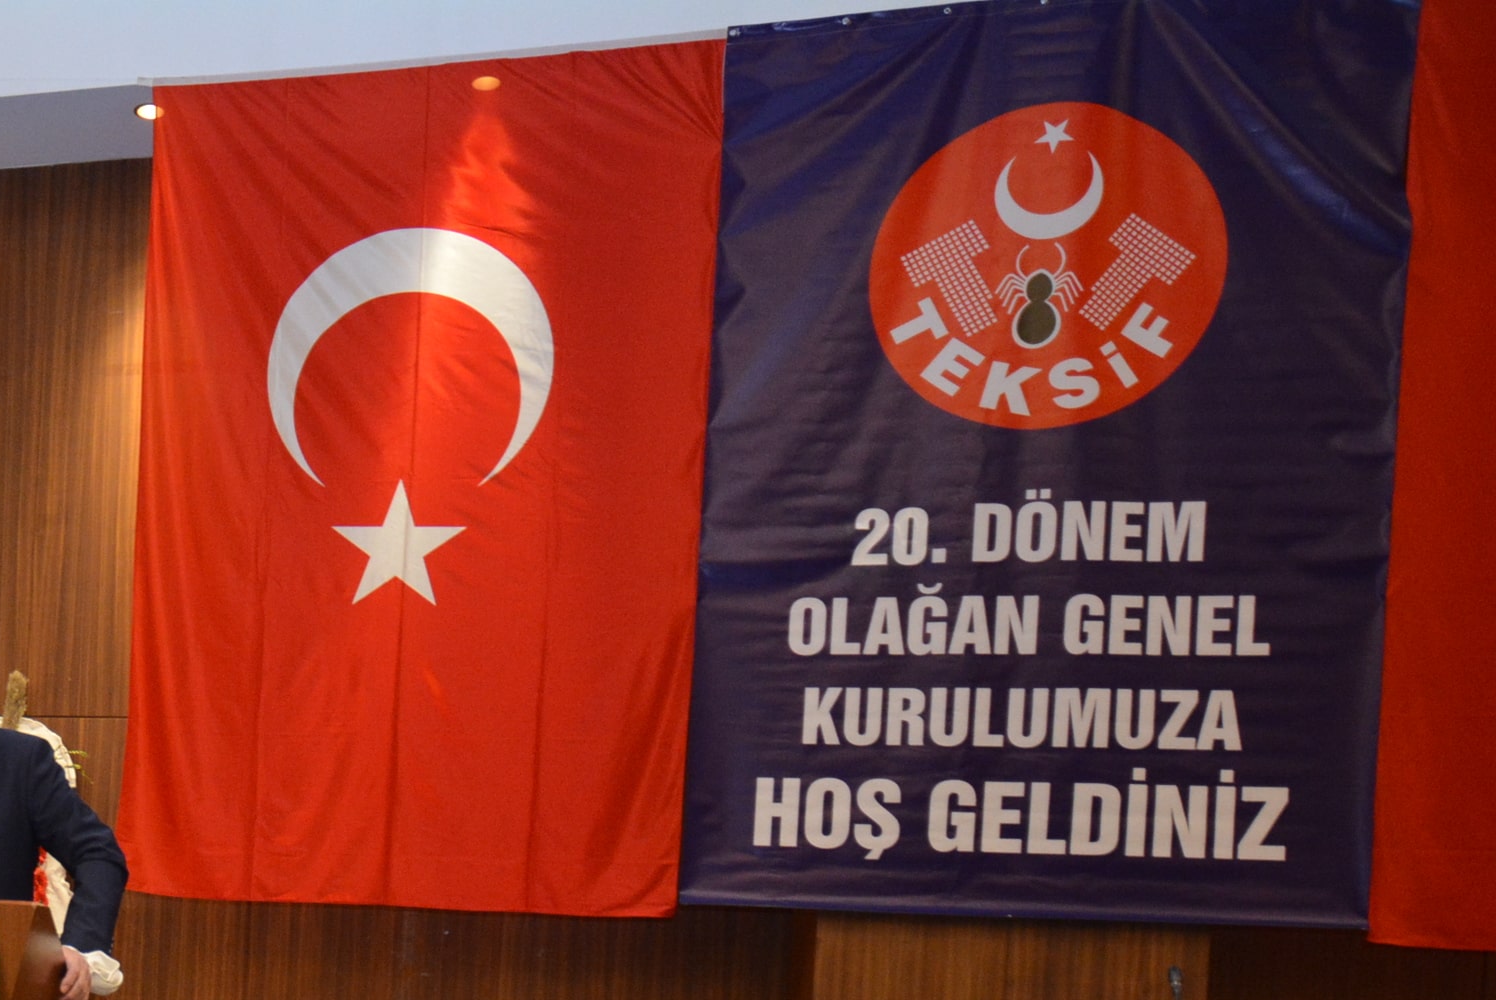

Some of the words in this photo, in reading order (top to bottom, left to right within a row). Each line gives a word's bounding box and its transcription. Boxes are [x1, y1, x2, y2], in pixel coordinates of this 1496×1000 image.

[890, 299, 1174, 416] TEKSİF
[850, 506, 948, 567] 20.
[972, 489, 1207, 563] DÖNEM
[787, 582, 1037, 656] OLAĞAN
[1062, 593, 1270, 657] GENEL
[801, 686, 1242, 752] KURULUMUZA
[752, 777, 901, 859] HOŞ
[927, 767, 1289, 862] GELDİNİZ
